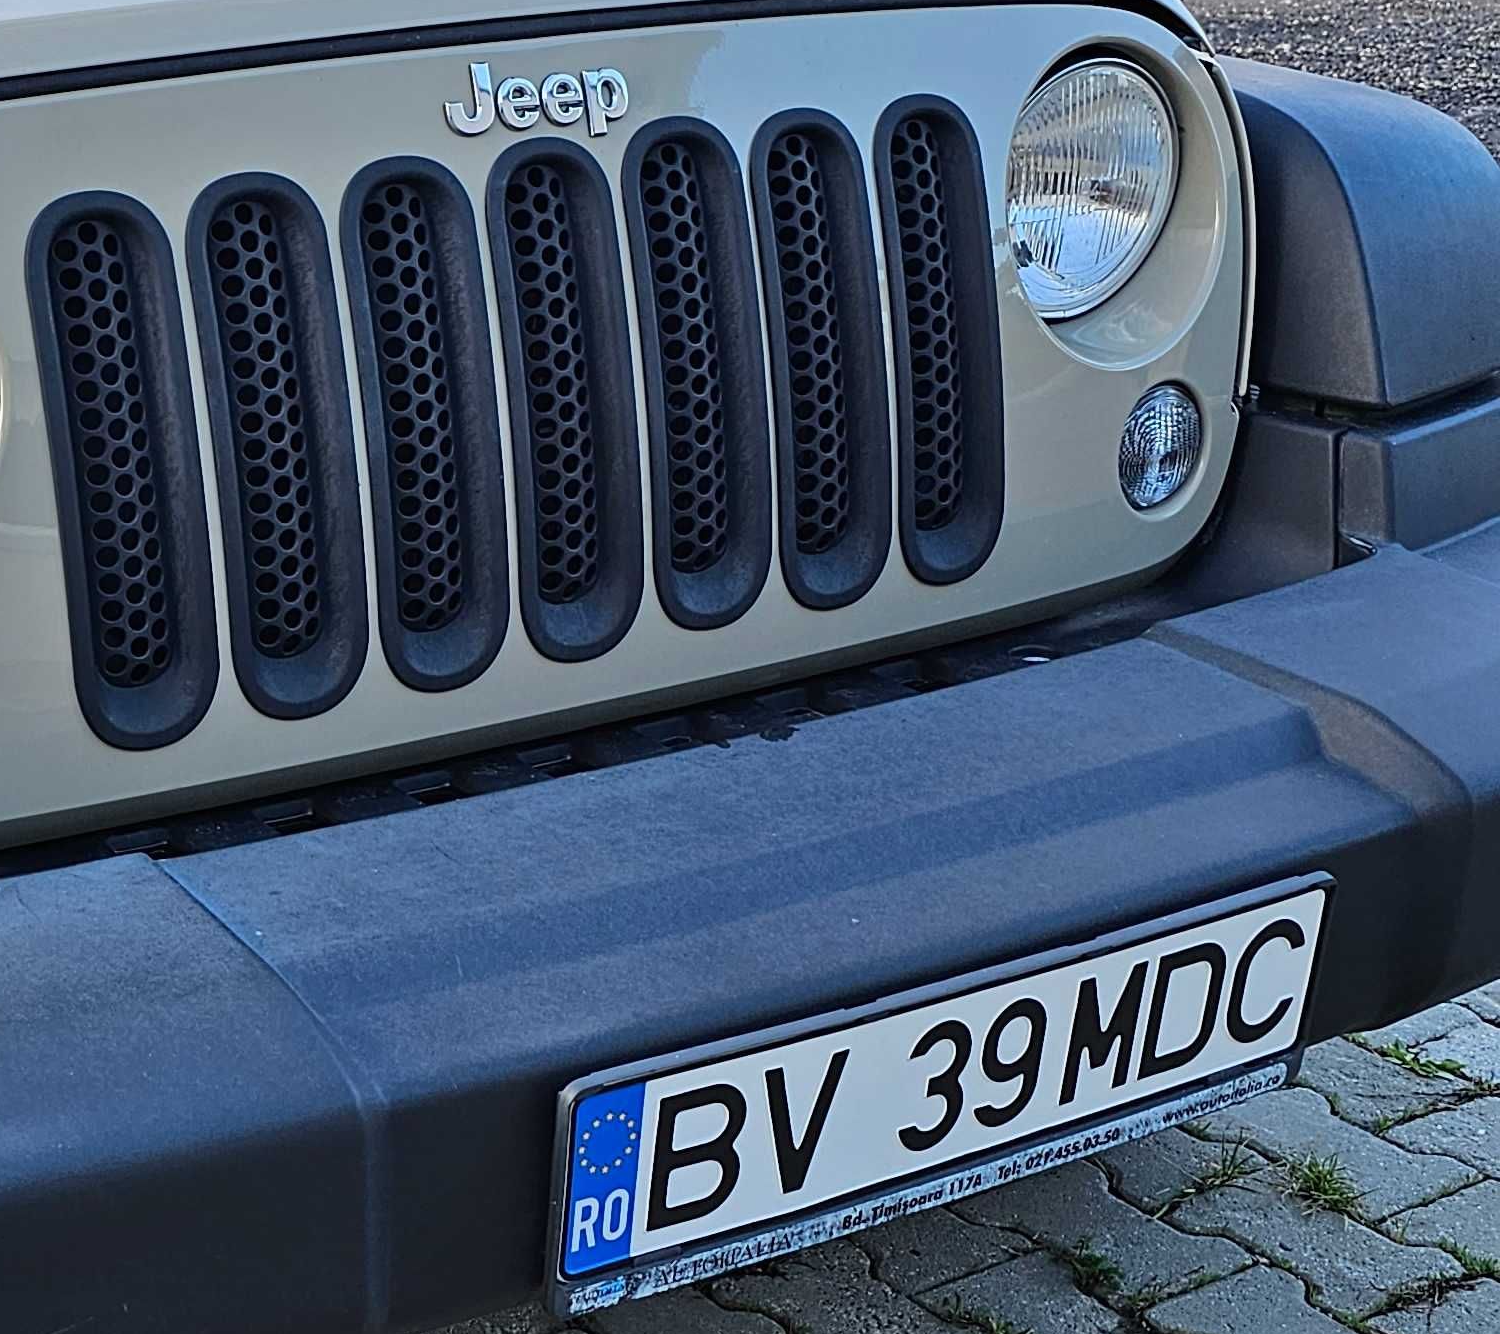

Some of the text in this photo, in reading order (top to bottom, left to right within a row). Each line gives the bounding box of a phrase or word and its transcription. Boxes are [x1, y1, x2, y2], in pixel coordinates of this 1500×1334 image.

[444, 61, 630, 137] Jeep
[646, 918, 1306, 1232] BV 39 MDC
[570, 1188, 630, 1254] RO
[949, 1175, 983, 1196] 117A
